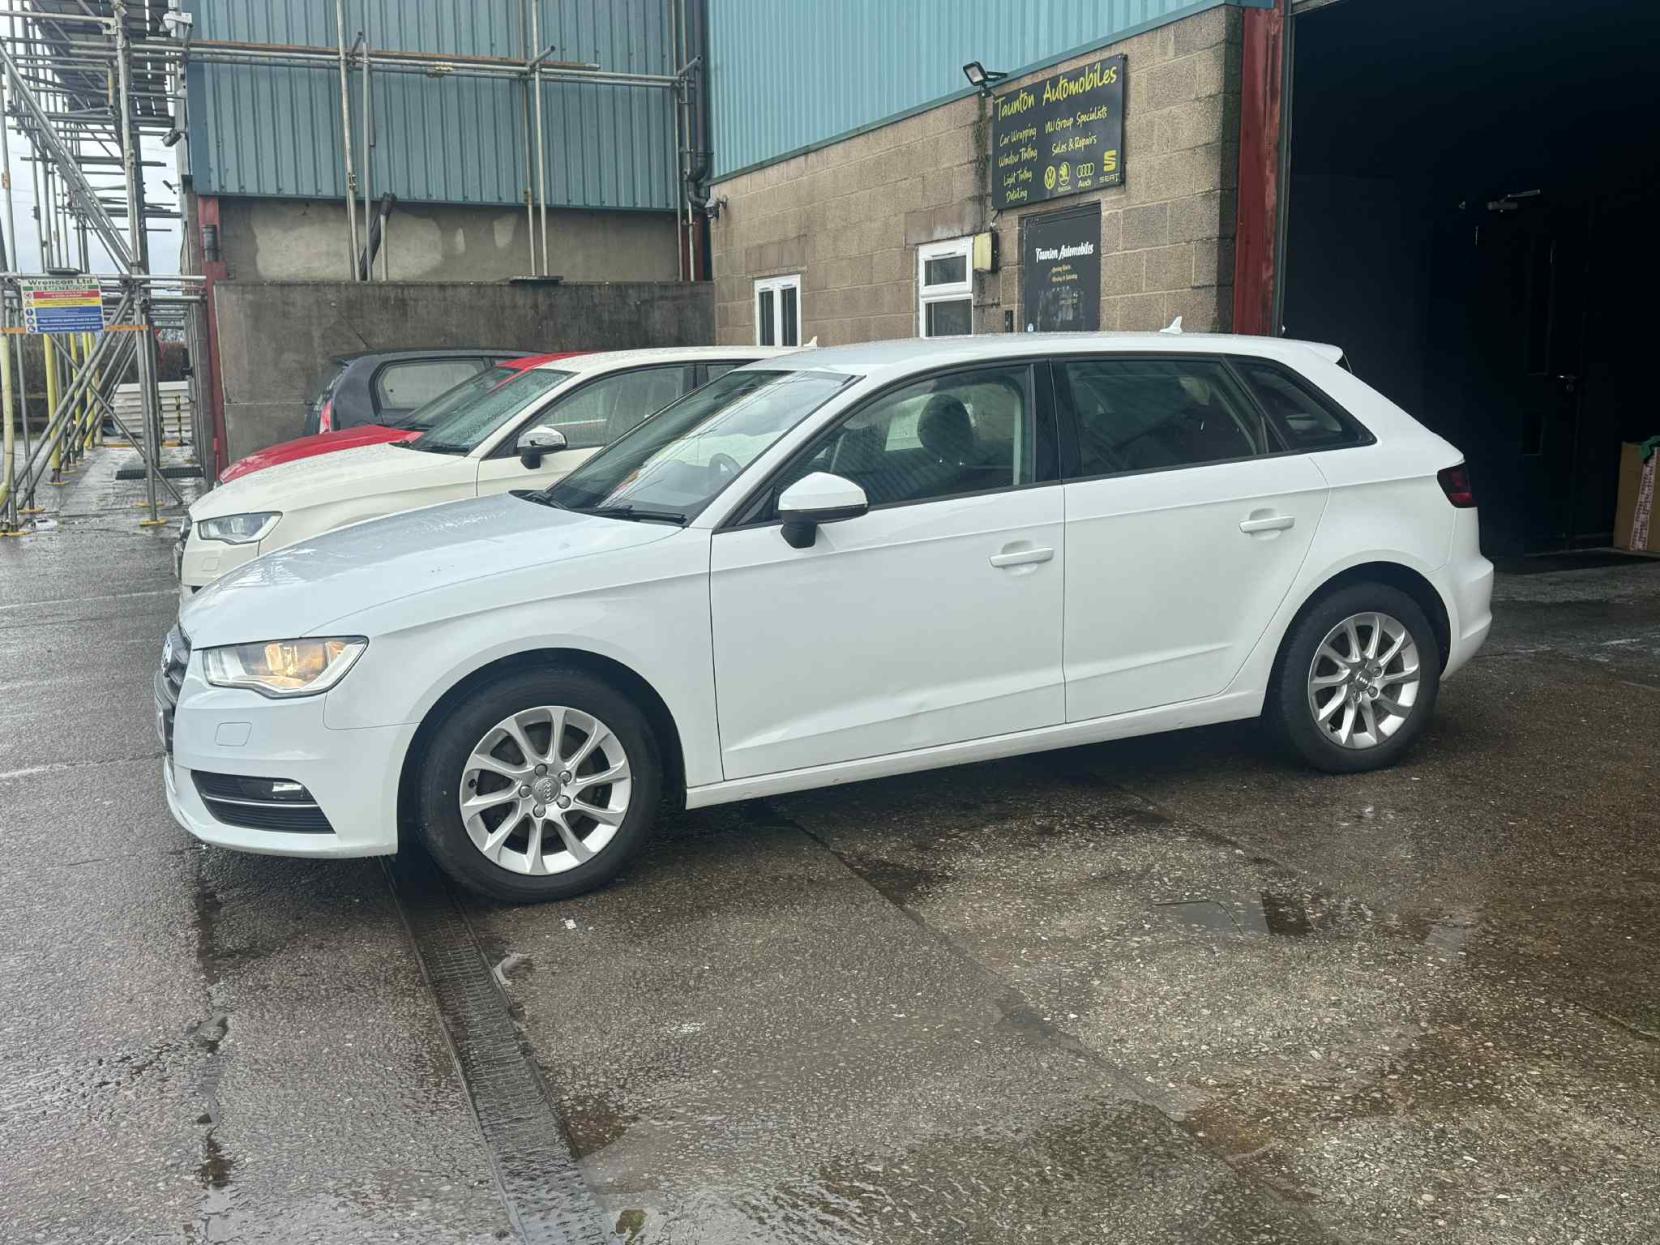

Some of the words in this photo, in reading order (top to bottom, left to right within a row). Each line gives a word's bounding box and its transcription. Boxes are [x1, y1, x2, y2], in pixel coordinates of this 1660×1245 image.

[994, 89, 1035, 120] Taunton
[1042, 62, 1118, 106] Automobiles
[1056, 116, 1073, 131] Group
[1076, 104, 1108, 127] Specialists
[1000, 133, 1010, 147] Car
[1011, 123, 1037, 143] Wrapping
[1051, 142, 1067, 156] Sales
[1099, 173, 1120, 183] SEAT
